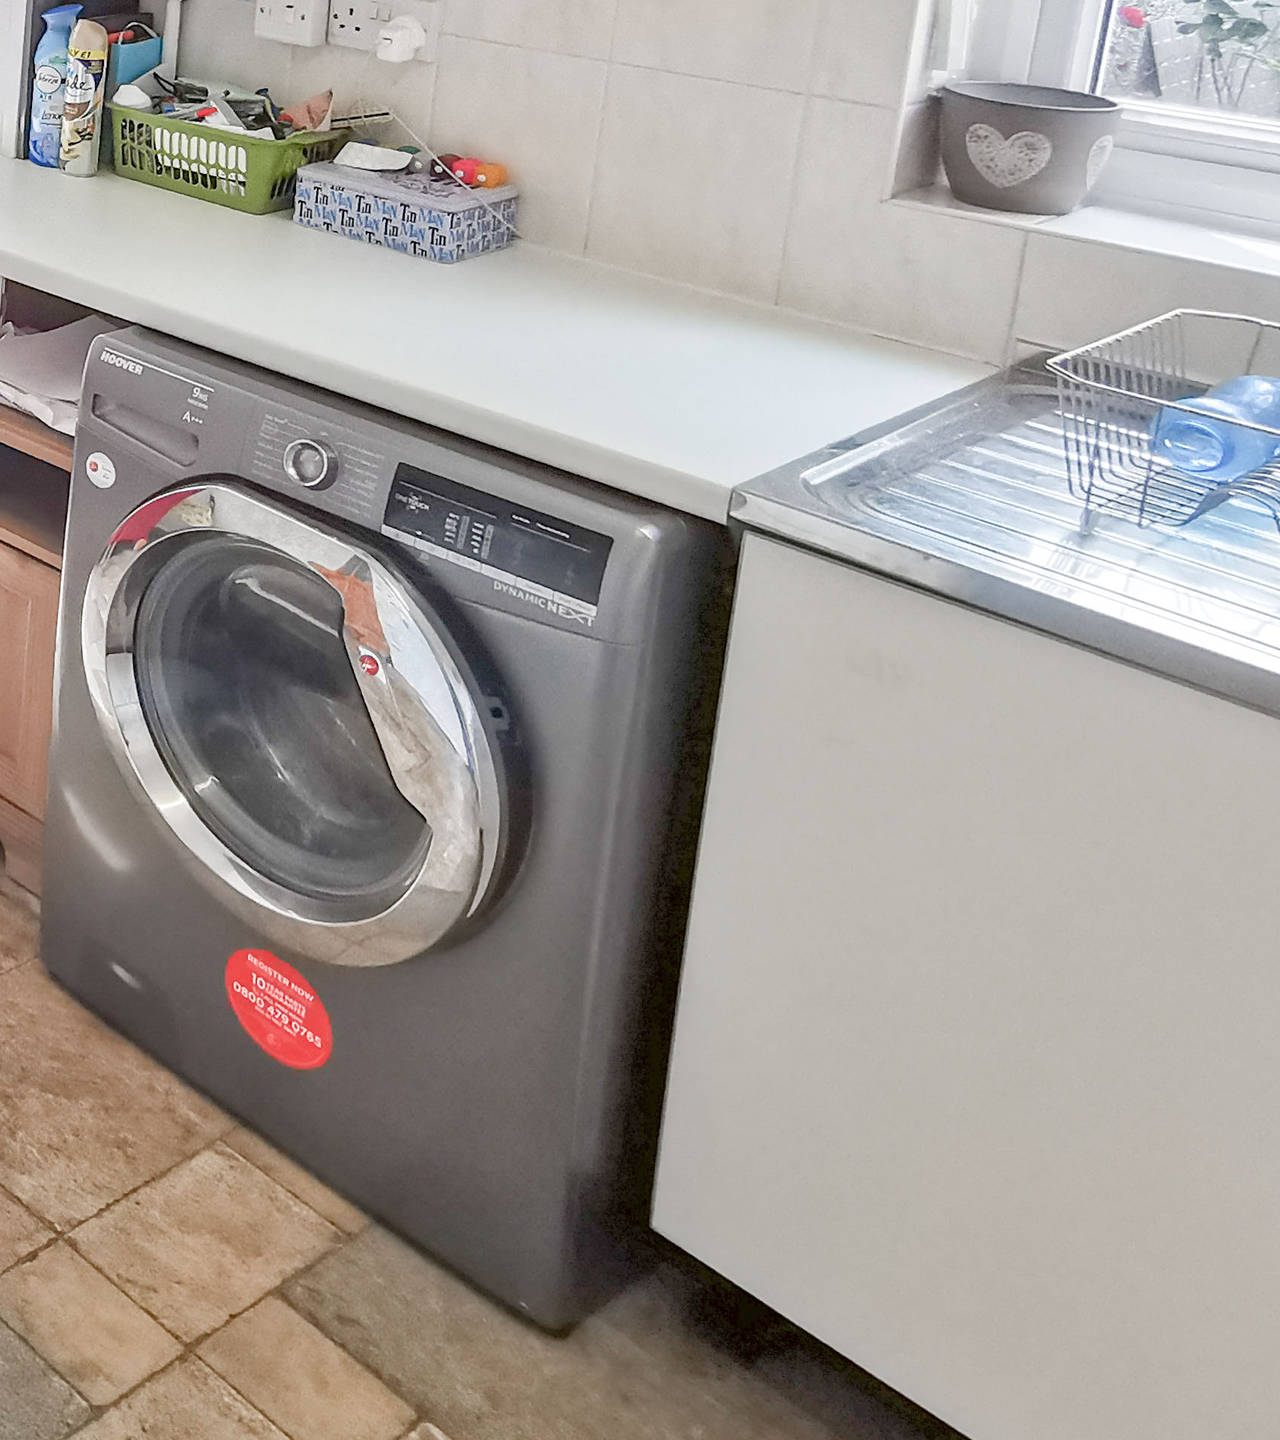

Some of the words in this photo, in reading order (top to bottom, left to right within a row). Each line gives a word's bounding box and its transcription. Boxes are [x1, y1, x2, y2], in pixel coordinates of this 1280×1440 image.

[355, 194, 371, 214] Tin
[400, 203, 417, 223] Tin
[298, 200, 313, 219] Tin
[339, 208, 354, 227] Tin
[382, 217, 399, 237] Tin
[427, 226, 446, 246] Tin
[100, 350, 143, 376] HOOVER
[547, 603, 595, 627] NEXT
[251, 972, 266, 990] 10
[233, 981, 265, 1008] 0800
[267, 1006, 289, 1025] 479
[291, 1021, 322, 1048] 0765
